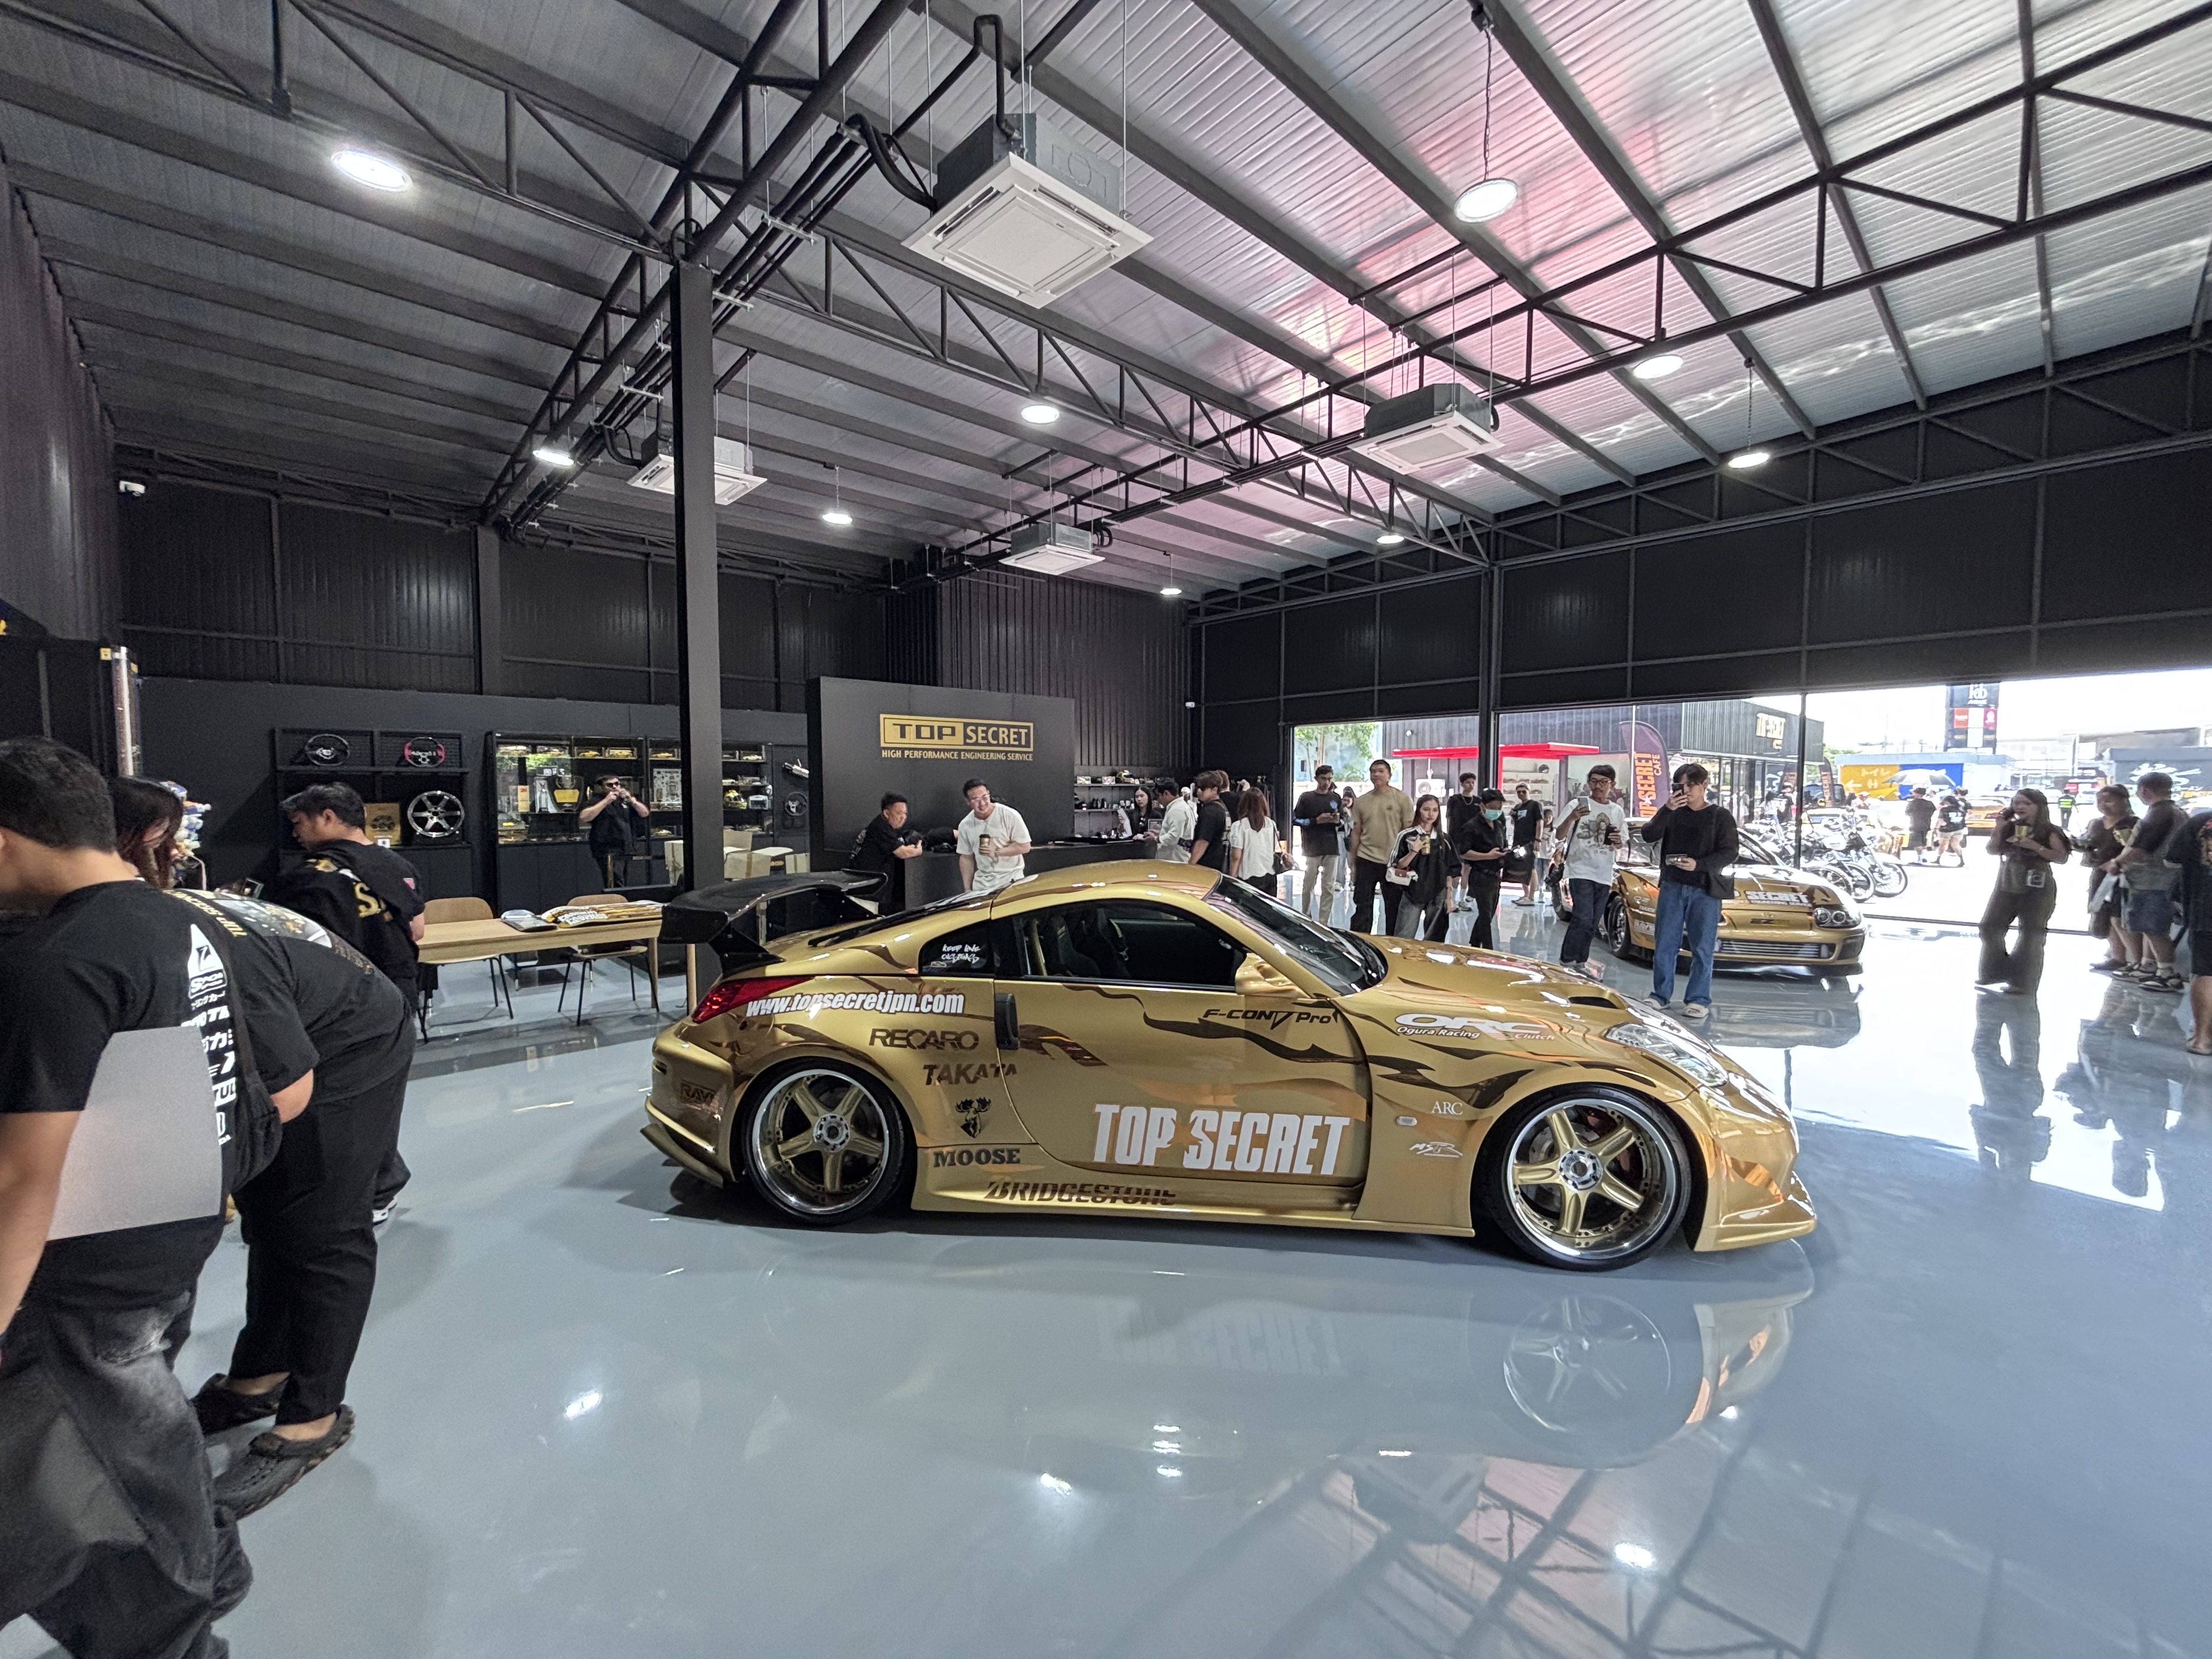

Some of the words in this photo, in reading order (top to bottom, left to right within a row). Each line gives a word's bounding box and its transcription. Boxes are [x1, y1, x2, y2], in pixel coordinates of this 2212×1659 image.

[893, 723, 956, 740] TOP
[966, 725, 1028, 745] SECRET
[881, 749, 901, 758] HIGH
[904, 750, 958, 759] PERFORMANCE
[961, 752, 1006, 761] ENGINEERING
[1007, 753, 1033, 761] SERVICE
[1652, 754, 1662, 776] CAFE
[1634, 752, 1657, 800] SECRET
[1639, 801, 1657, 817] OP
[745, 989, 966, 1018] www.topsecretjpn.com
[1295, 1012, 1332, 1024] Pro
[869, 1028, 979, 1051] RECARO
[1397, 1026, 1435, 1035] Ogura
[1438, 1029, 1480, 1040] Racing
[1514, 1032, 1555, 1041] Clutch
[923, 1063, 1017, 1086] TAKATA
[1431, 1101, 1463, 1115] ARC
[1093, 1104, 1177, 1166] TOP
[1183, 1109, 1351, 1176] SECRET
[933, 1148, 1020, 1167] MOOSE
